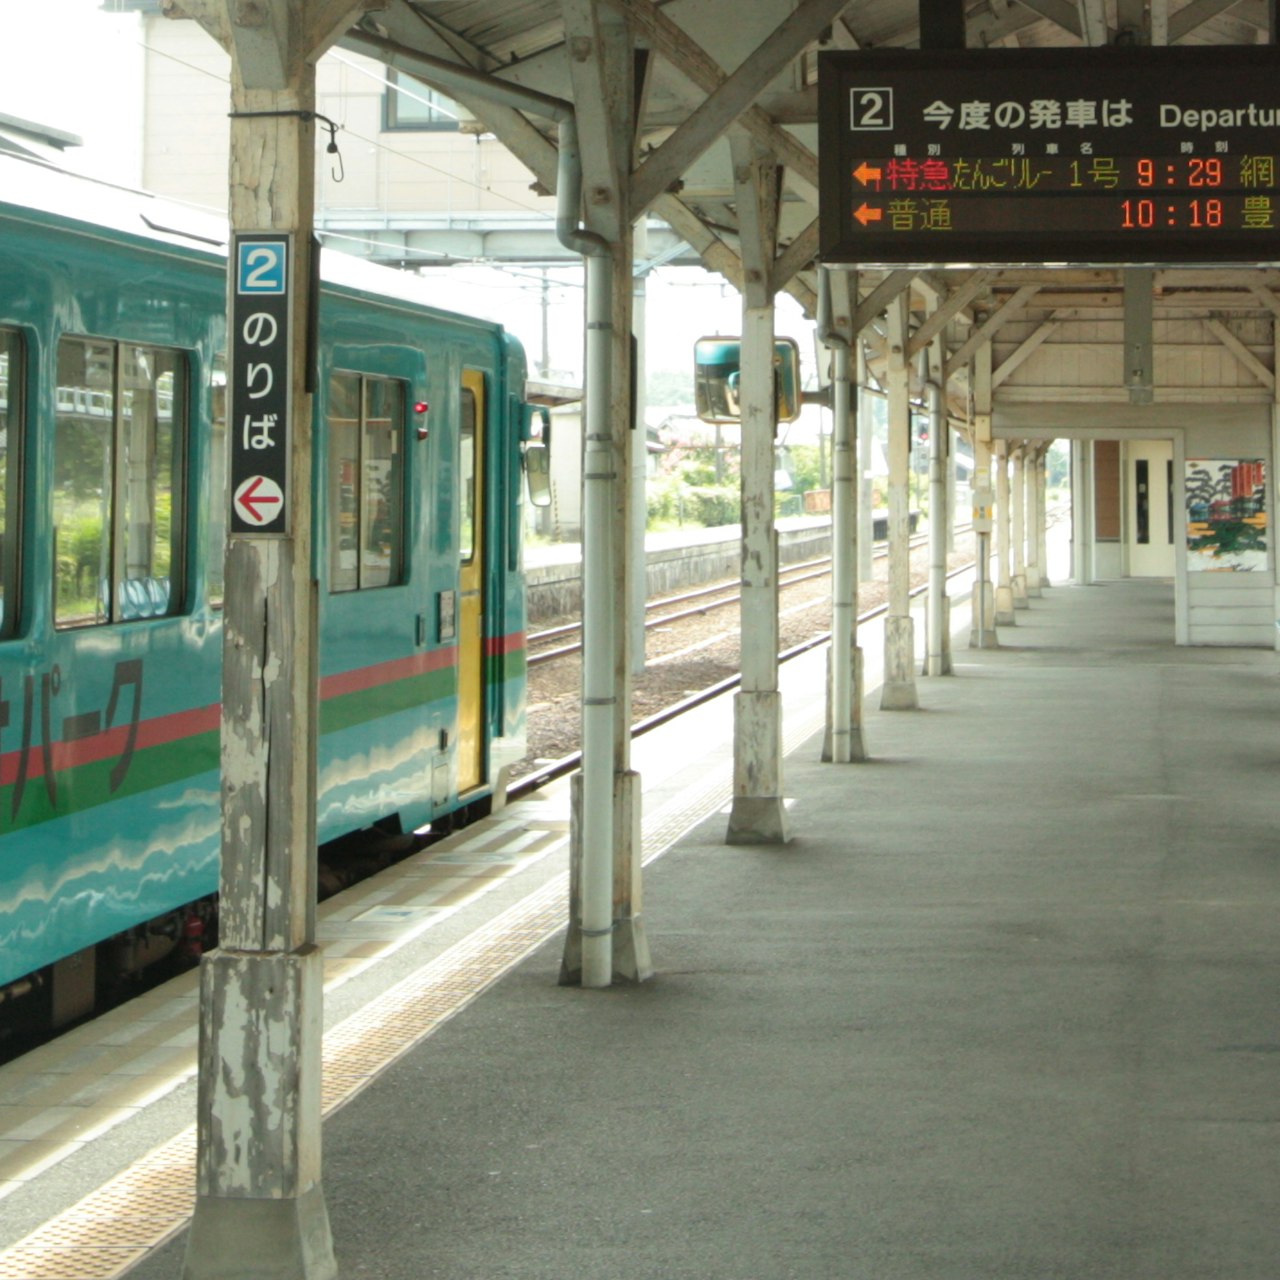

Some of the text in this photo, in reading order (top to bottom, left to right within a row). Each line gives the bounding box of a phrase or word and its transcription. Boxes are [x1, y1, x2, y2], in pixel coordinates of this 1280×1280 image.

[860, 92, 884, 125] 2
[922, 98, 1134, 130] 今度の発車は
[885, 157, 952, 191] 特急
[1136, 158, 1222, 187] 9:29
[886, 197, 953, 231] 普通
[1121, 198, 1223, 229] 10:18
[245, 248, 278, 288] 2
[242, 311, 278, 451] のりば
